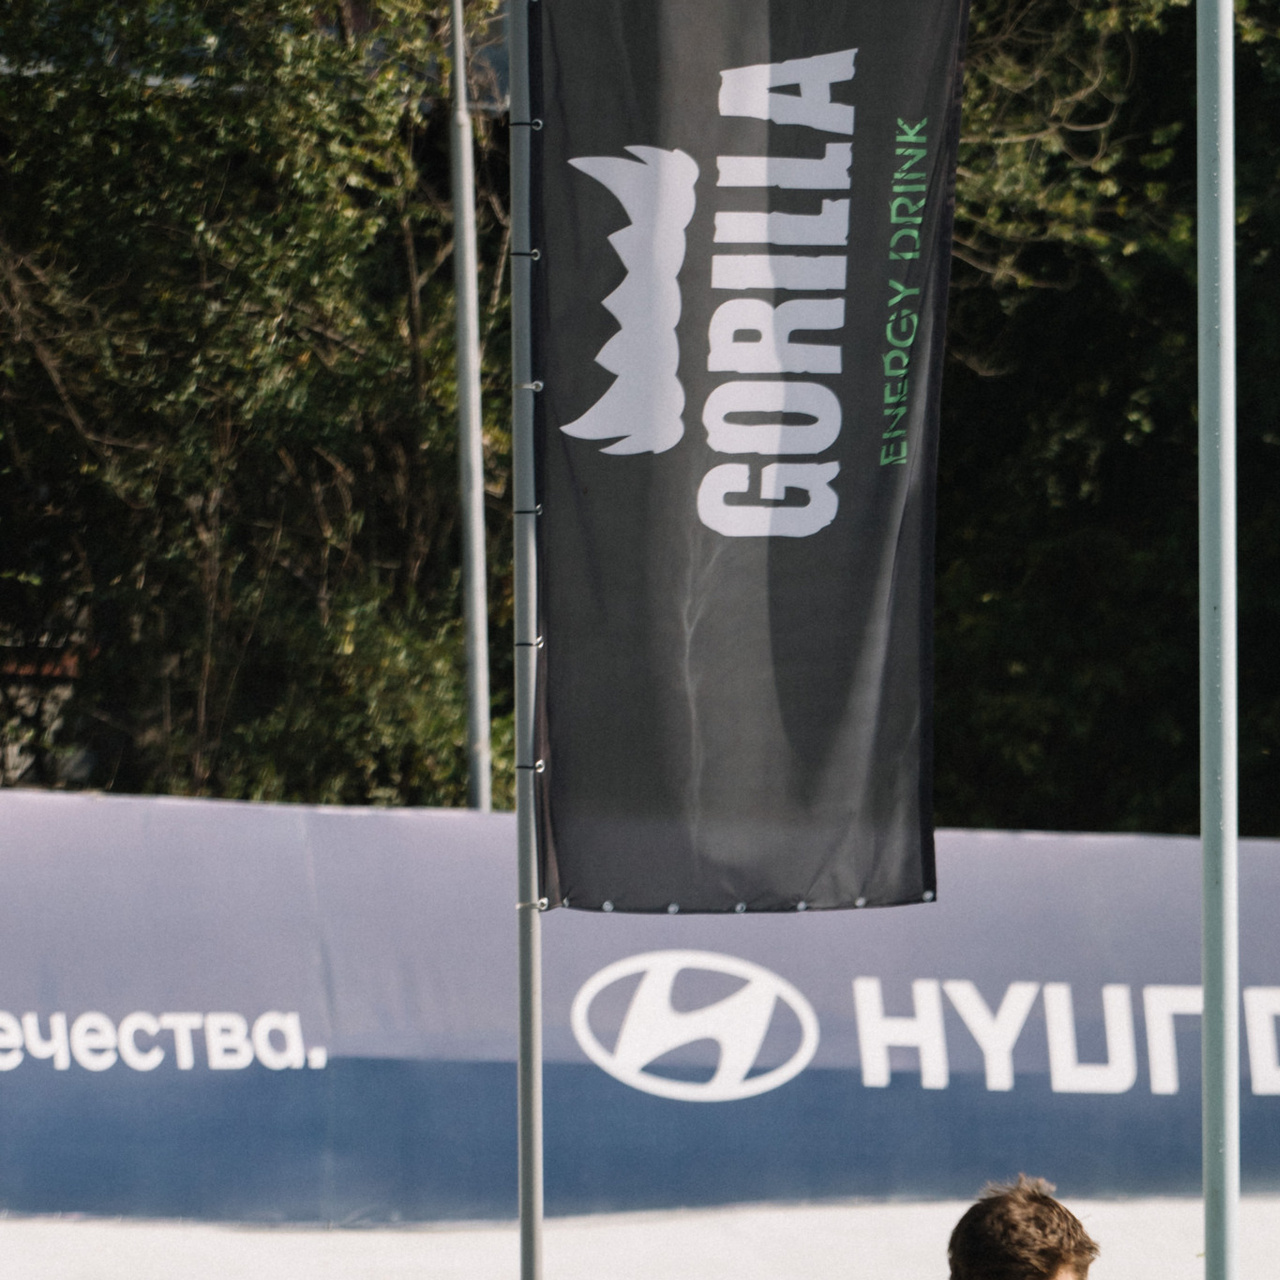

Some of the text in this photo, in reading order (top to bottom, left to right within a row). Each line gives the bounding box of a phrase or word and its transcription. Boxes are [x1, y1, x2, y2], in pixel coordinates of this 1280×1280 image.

[698, 48, 858, 537] GORILLA
[880, 117, 927, 465] ENERGY DRINK
